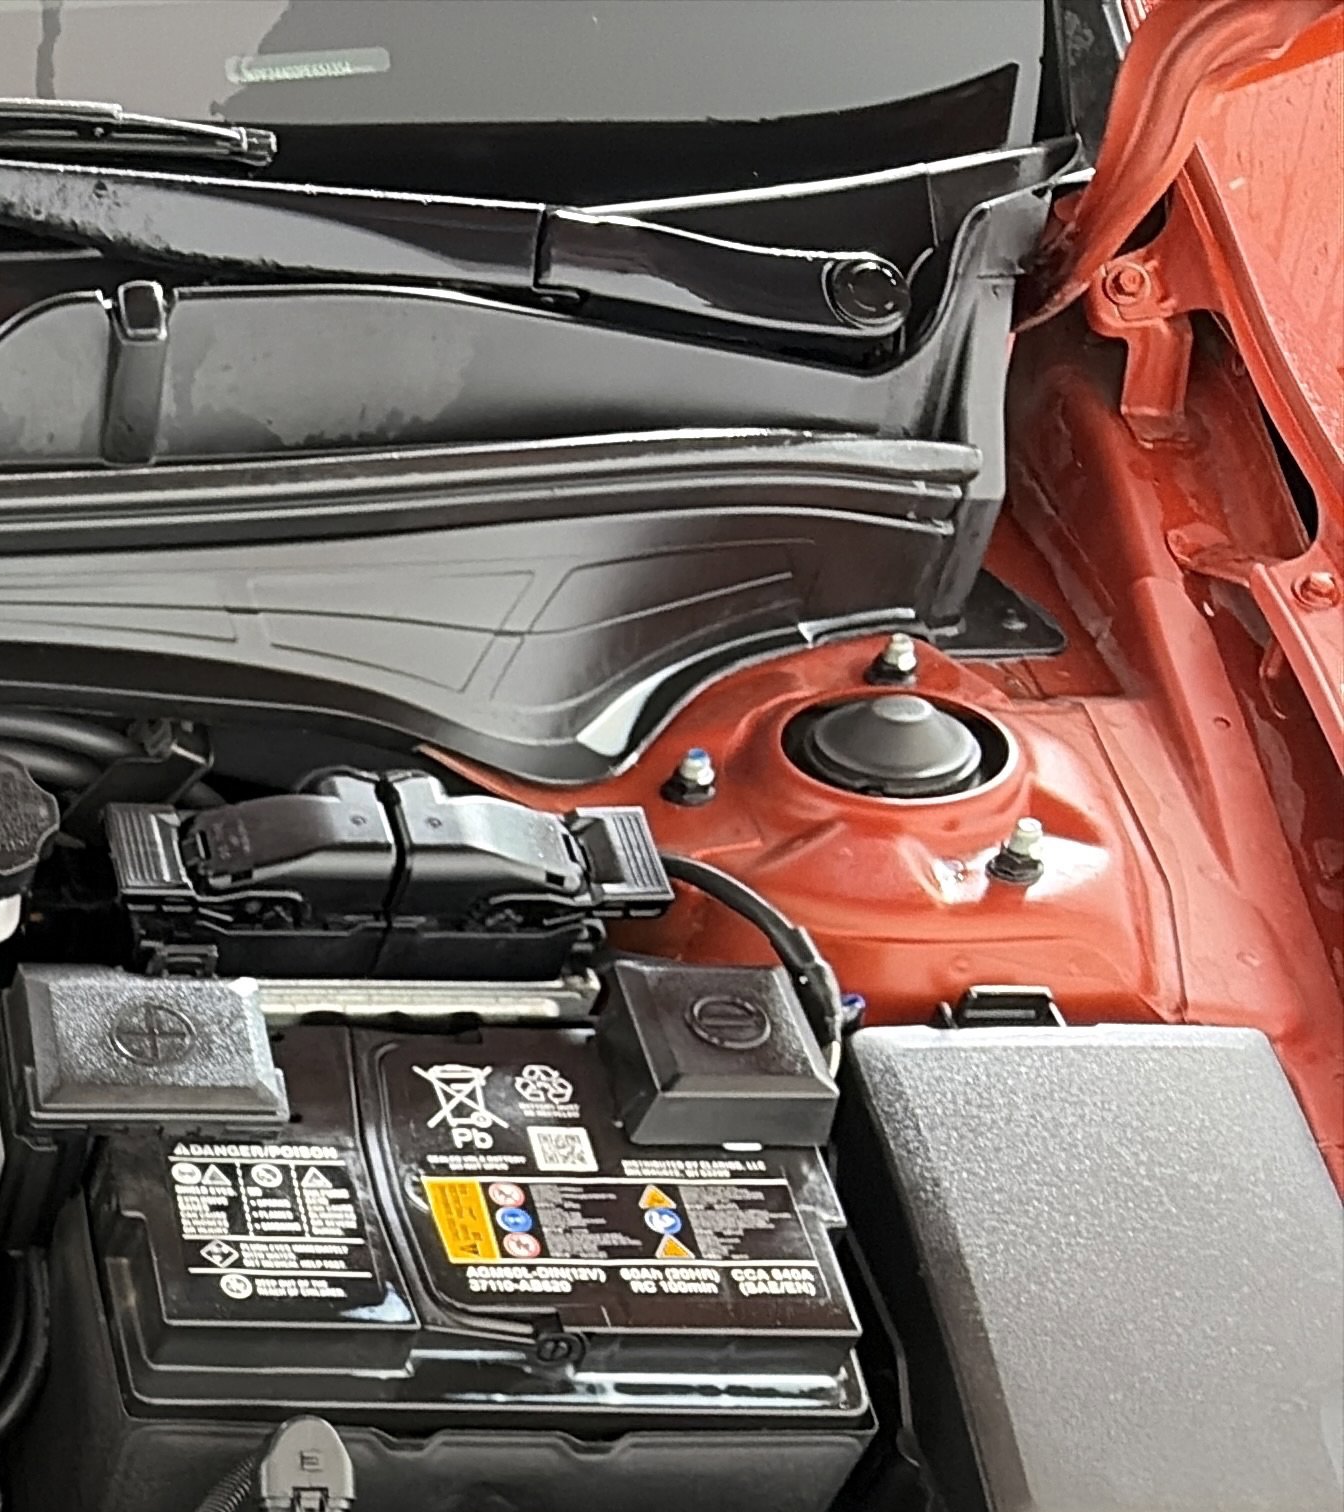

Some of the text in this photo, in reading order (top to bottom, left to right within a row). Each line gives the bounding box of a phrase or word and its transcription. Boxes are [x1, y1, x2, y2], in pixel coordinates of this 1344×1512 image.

[451, 1128, 494, 1150] Pb
[189, 1143, 339, 1159] DANGER/POISON
[731, 1268, 769, 1281] CCA
[631, 1281, 657, 1293] RC
